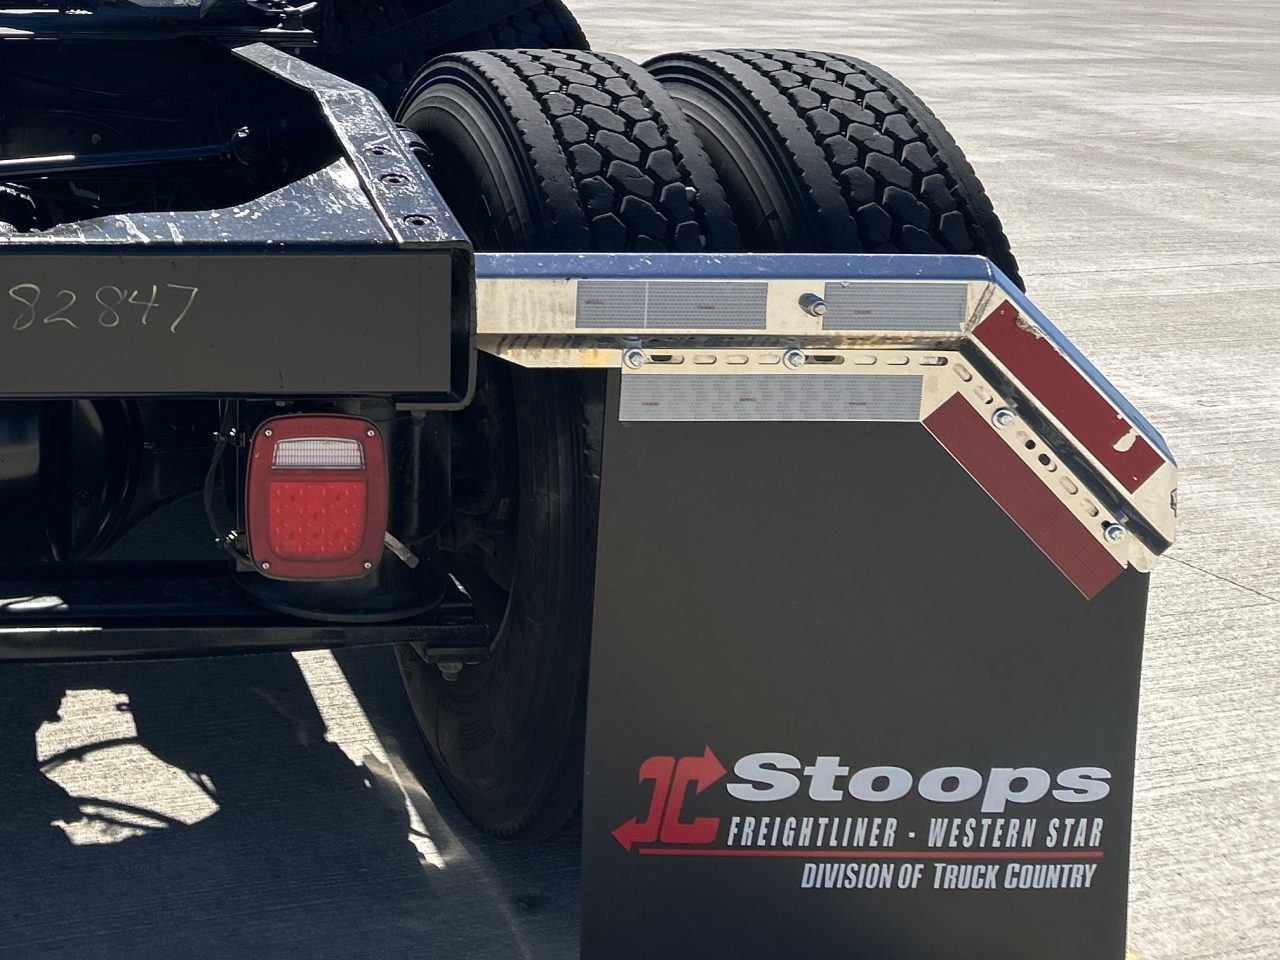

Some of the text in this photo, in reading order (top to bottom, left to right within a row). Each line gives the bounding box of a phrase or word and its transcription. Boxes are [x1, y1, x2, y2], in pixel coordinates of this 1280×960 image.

[726, 752, 1112, 813] Stoops
[727, 816, 898, 847] FREIGHTLINER
[927, 817, 1037, 848] WESTERN
[1045, 817, 1104, 848] STAR
[801, 862, 1098, 889] DIVISION OF TRUCK COUNTRY
